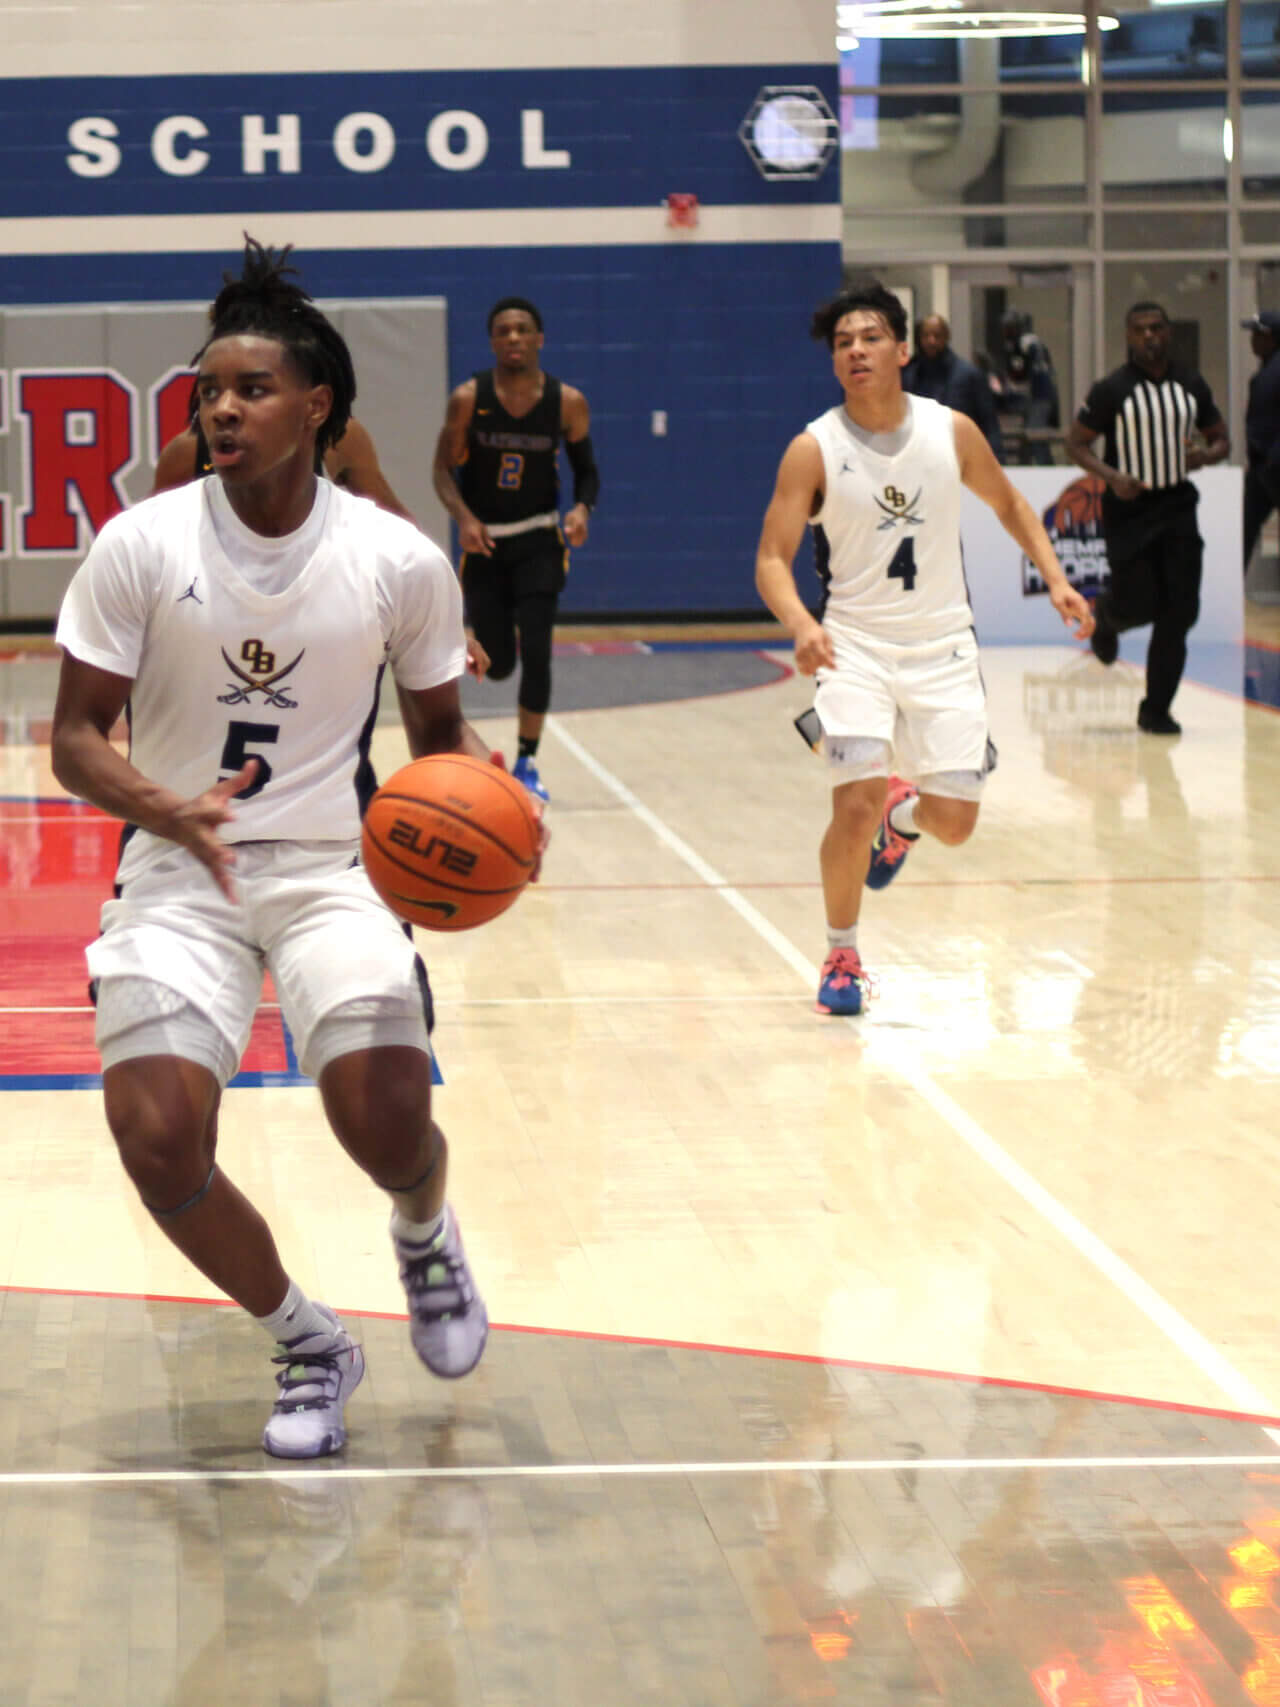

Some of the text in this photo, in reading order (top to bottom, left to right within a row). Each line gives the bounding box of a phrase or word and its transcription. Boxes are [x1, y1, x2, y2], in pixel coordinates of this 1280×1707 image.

[66, 109, 571, 178] SCHOOL
[497, 452, 524, 490] 2
[887, 536, 917, 590] 4
[218, 720, 280, 800] 5
